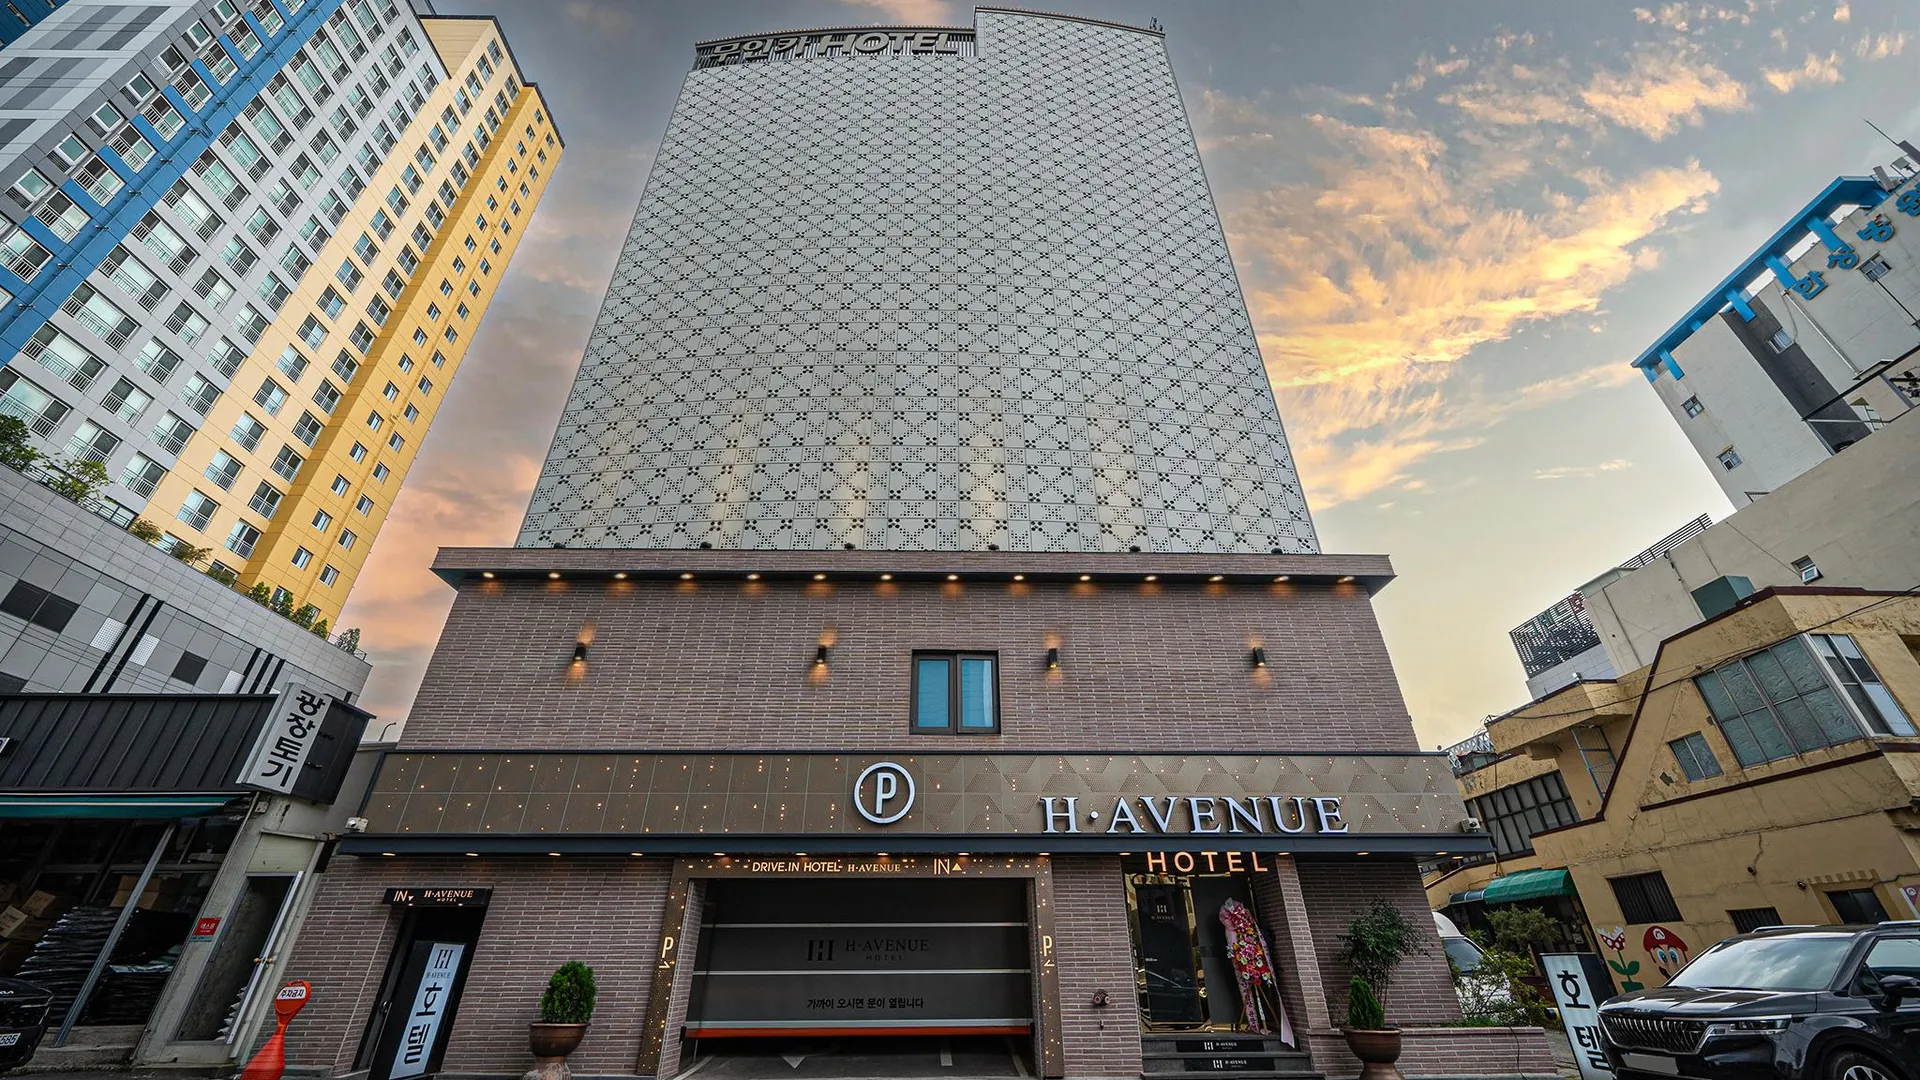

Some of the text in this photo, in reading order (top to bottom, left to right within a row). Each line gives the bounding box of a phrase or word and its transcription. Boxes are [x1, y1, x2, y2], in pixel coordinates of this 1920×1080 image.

[817, 32, 958, 54] HOTEL
[261, 689, 326, 788] 광장토기
[803, 861, 840, 872] HOTEL
[933, 858, 950, 875] IN
[1146, 851, 1268, 873] HOTEL
[393, 890, 409, 902] IN
[662, 936, 674, 958] P
[1042, 935, 1053, 957] P
[807, 997, 925, 1009] 가까이 오시면 문이 열립니다
[404, 982, 443, 1065] 호텔
[1557, 970, 1613, 1071] 호텔
